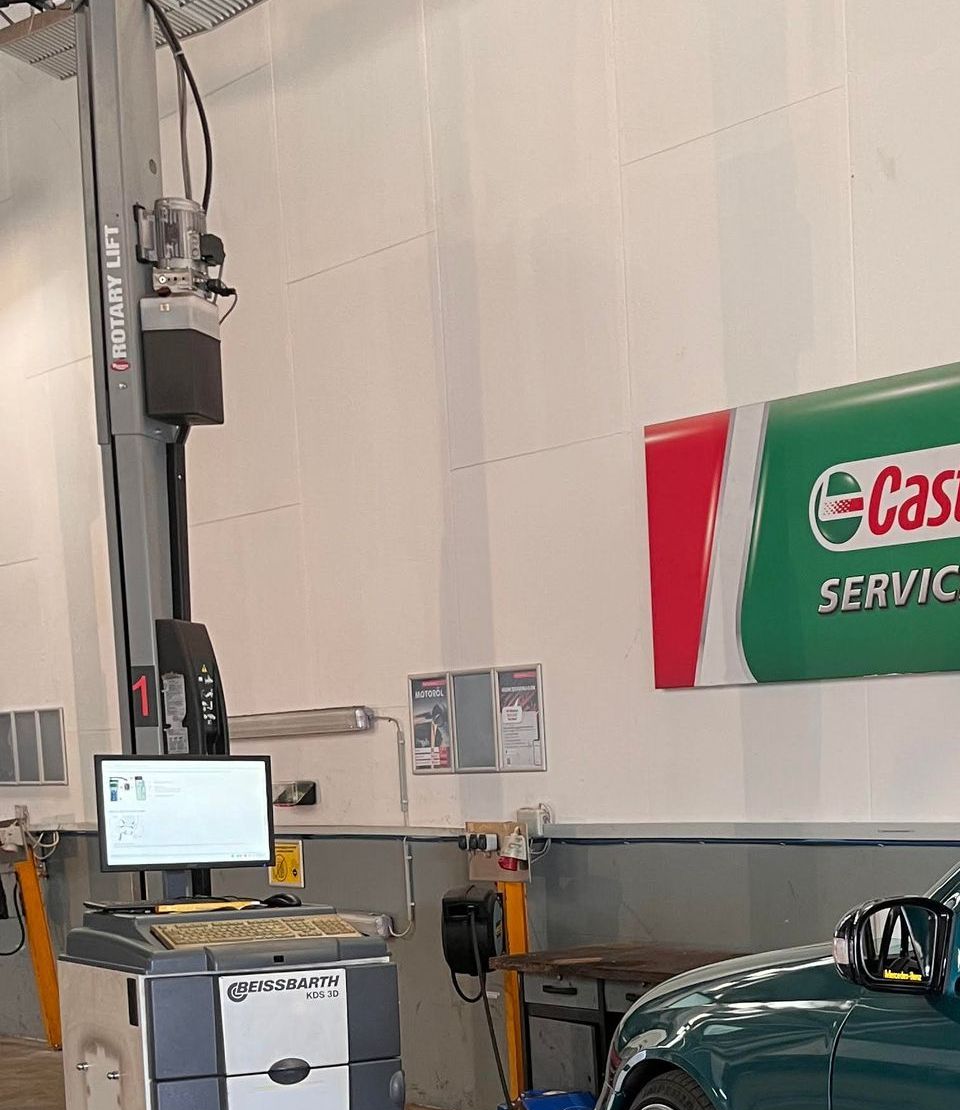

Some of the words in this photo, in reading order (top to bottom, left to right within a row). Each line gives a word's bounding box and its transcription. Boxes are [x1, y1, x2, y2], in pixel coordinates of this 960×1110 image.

[104, 224, 122, 269] LIFT
[107, 274, 127, 359] ROTARY
[132, 675, 149, 717] 1
[236, 975, 340, 994] BEISSBARTH
[306, 991, 325, 1000] KDS
[327, 990, 339, 998] 3D
